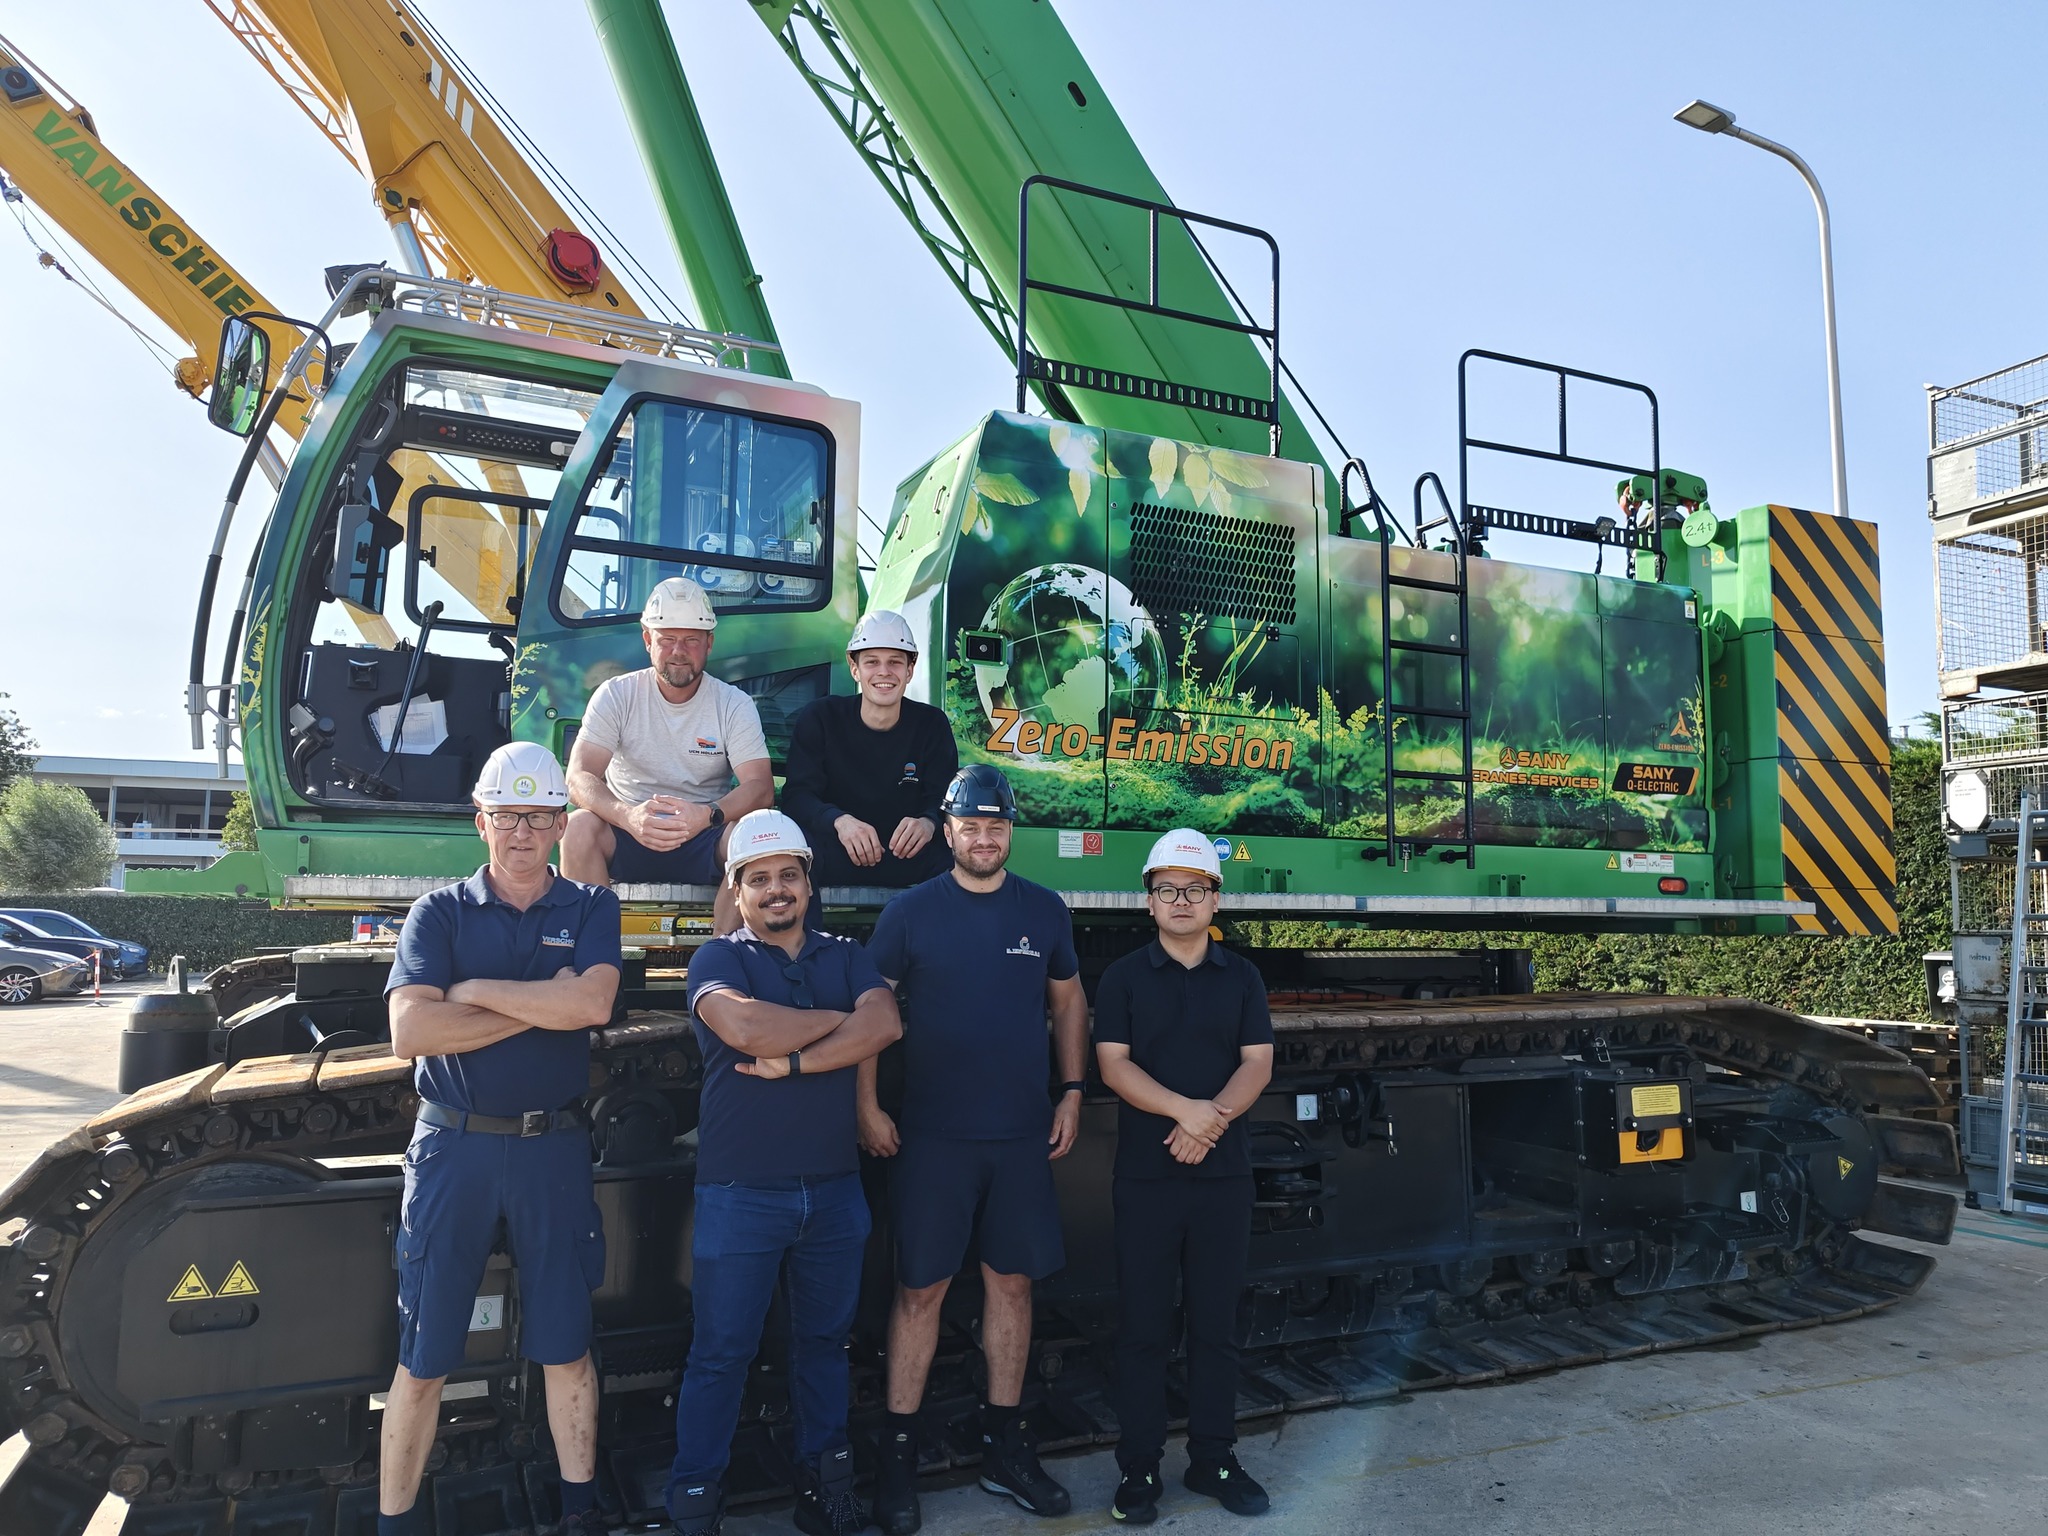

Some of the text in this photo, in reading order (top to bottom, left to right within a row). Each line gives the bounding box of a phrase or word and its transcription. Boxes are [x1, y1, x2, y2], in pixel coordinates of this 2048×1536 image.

[1685, 521, 1713, 538] 2.4t
[986, 708, 1294, 771] Zero-Emission
[1517, 751, 1571, 770] SANY
[1633, 765, 1675, 780] SANY
[1627, 780, 1680, 793] Q-ELECTRIC
[758, 832, 779, 840] SANY
[1182, 844, 1202, 852] SANY
